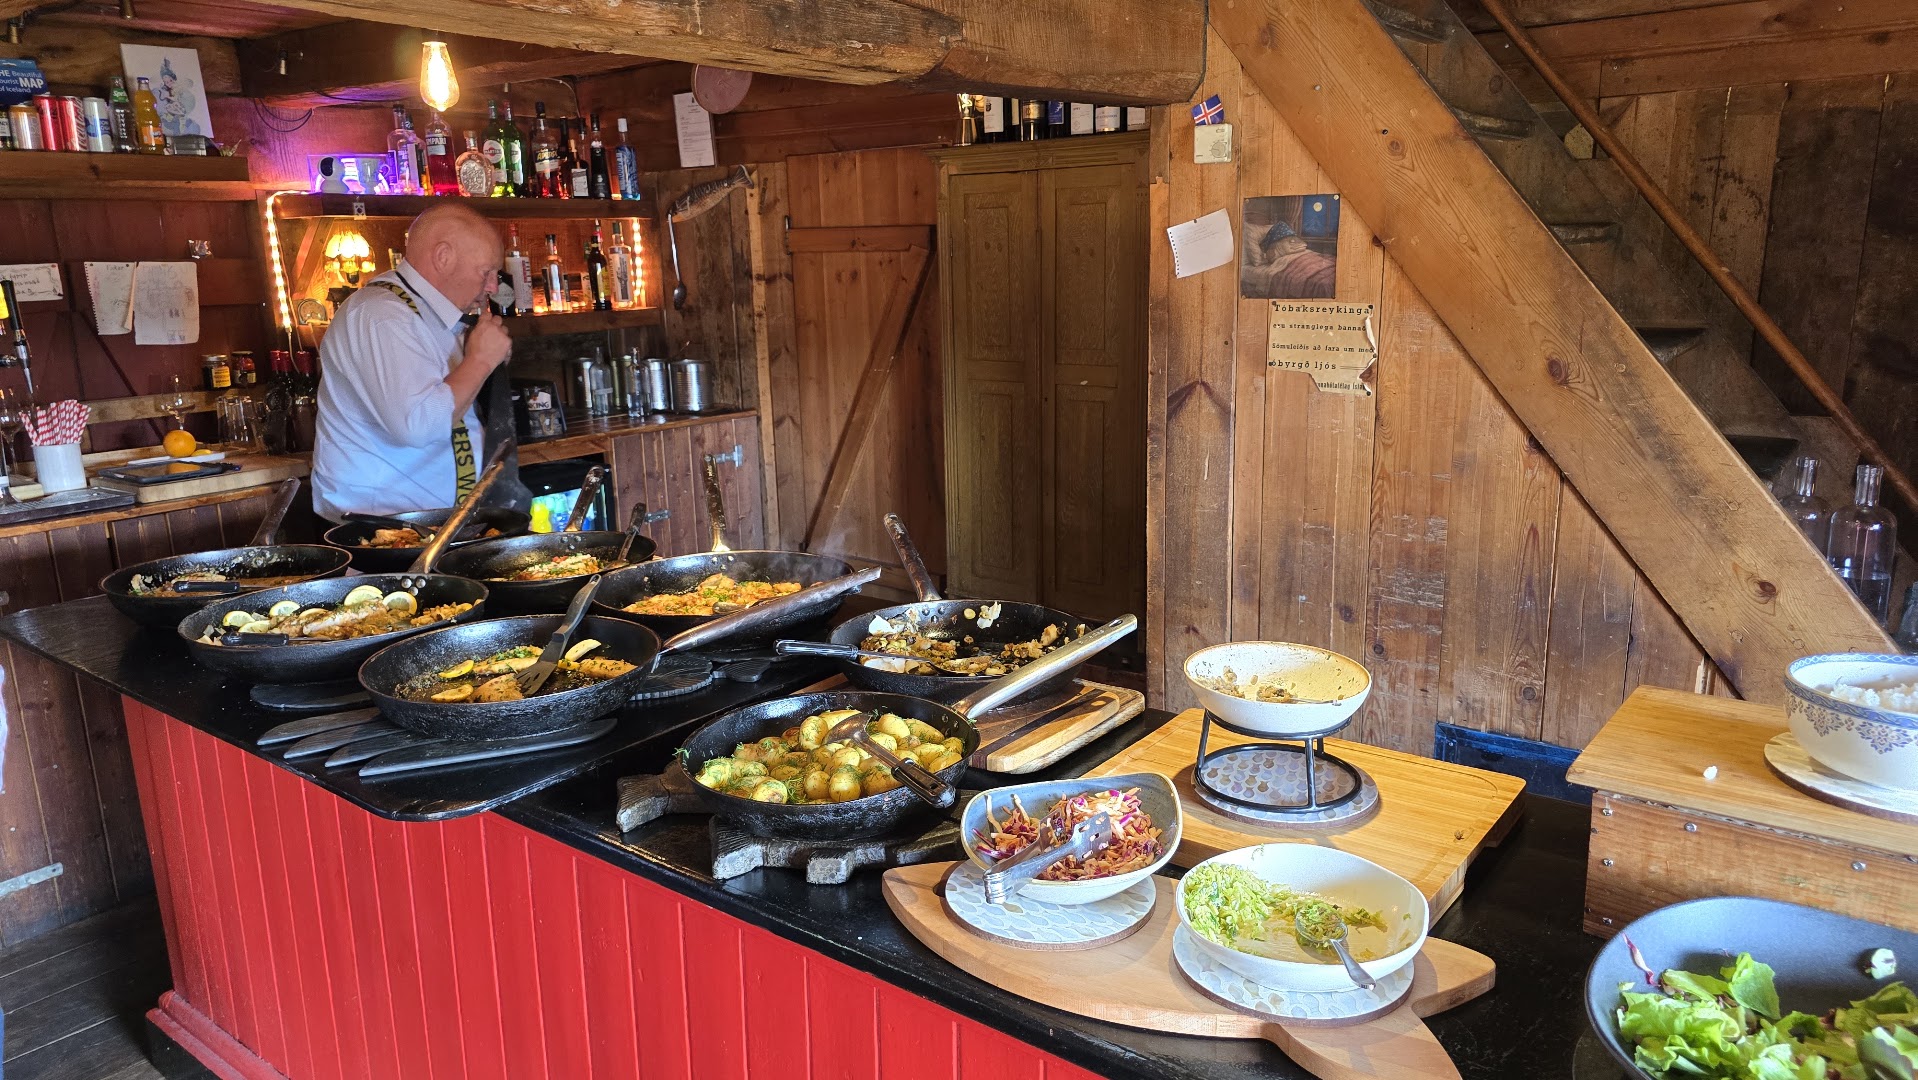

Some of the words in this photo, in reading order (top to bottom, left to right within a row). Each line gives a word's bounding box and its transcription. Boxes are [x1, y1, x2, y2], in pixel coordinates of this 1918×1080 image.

[11, 70, 42, 78] Beautiful
[19, 77, 44, 88] MAP
[426, 137, 447, 146] MPARI
[1274, 304, 1370, 316] Tóbaksreykinga
[1289, 323, 1334, 331] stranglega
[1325, 344, 1340, 352] fara
[1272, 359, 1310, 369] óbyrgð
[1314, 361, 1336, 370] ljós
